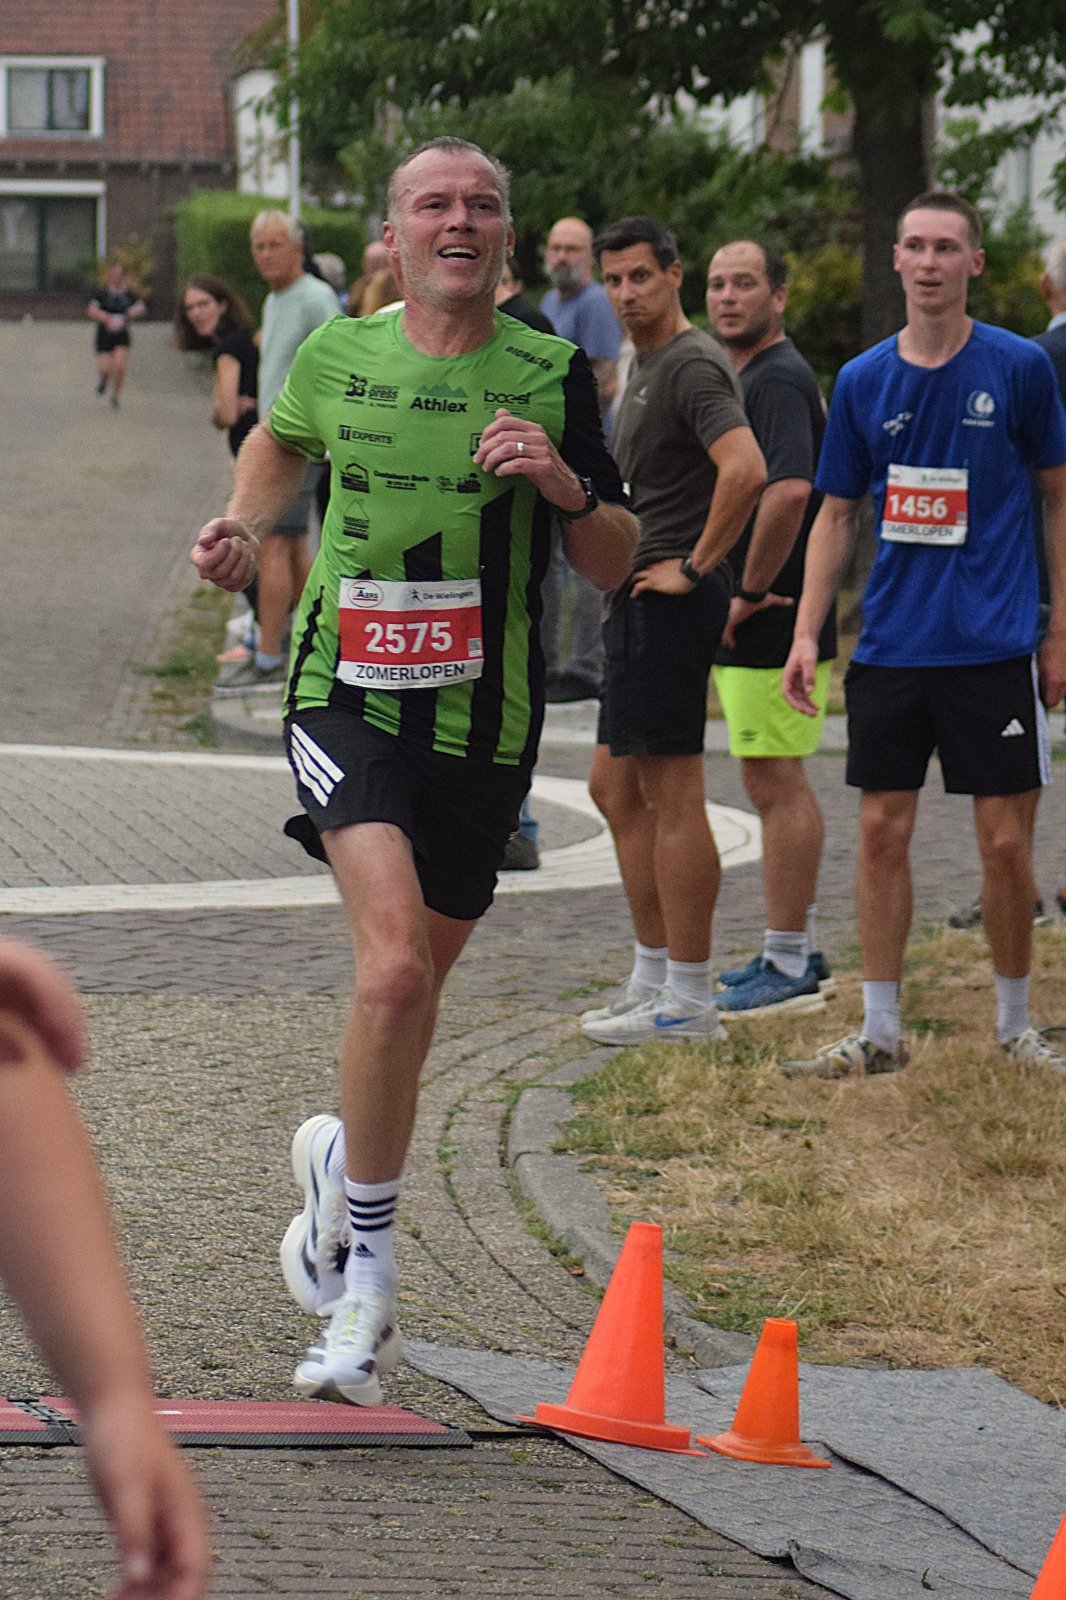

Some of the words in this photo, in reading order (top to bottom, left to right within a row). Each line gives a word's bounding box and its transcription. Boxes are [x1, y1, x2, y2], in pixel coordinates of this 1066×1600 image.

[409, 396, 468, 413] Athlex
[352, 430, 393, 445] EXPERTS
[889, 493, 949, 520] 1456
[364, 621, 453, 654] 2575
[355, 663, 465, 681] ZOMERLOPEN
